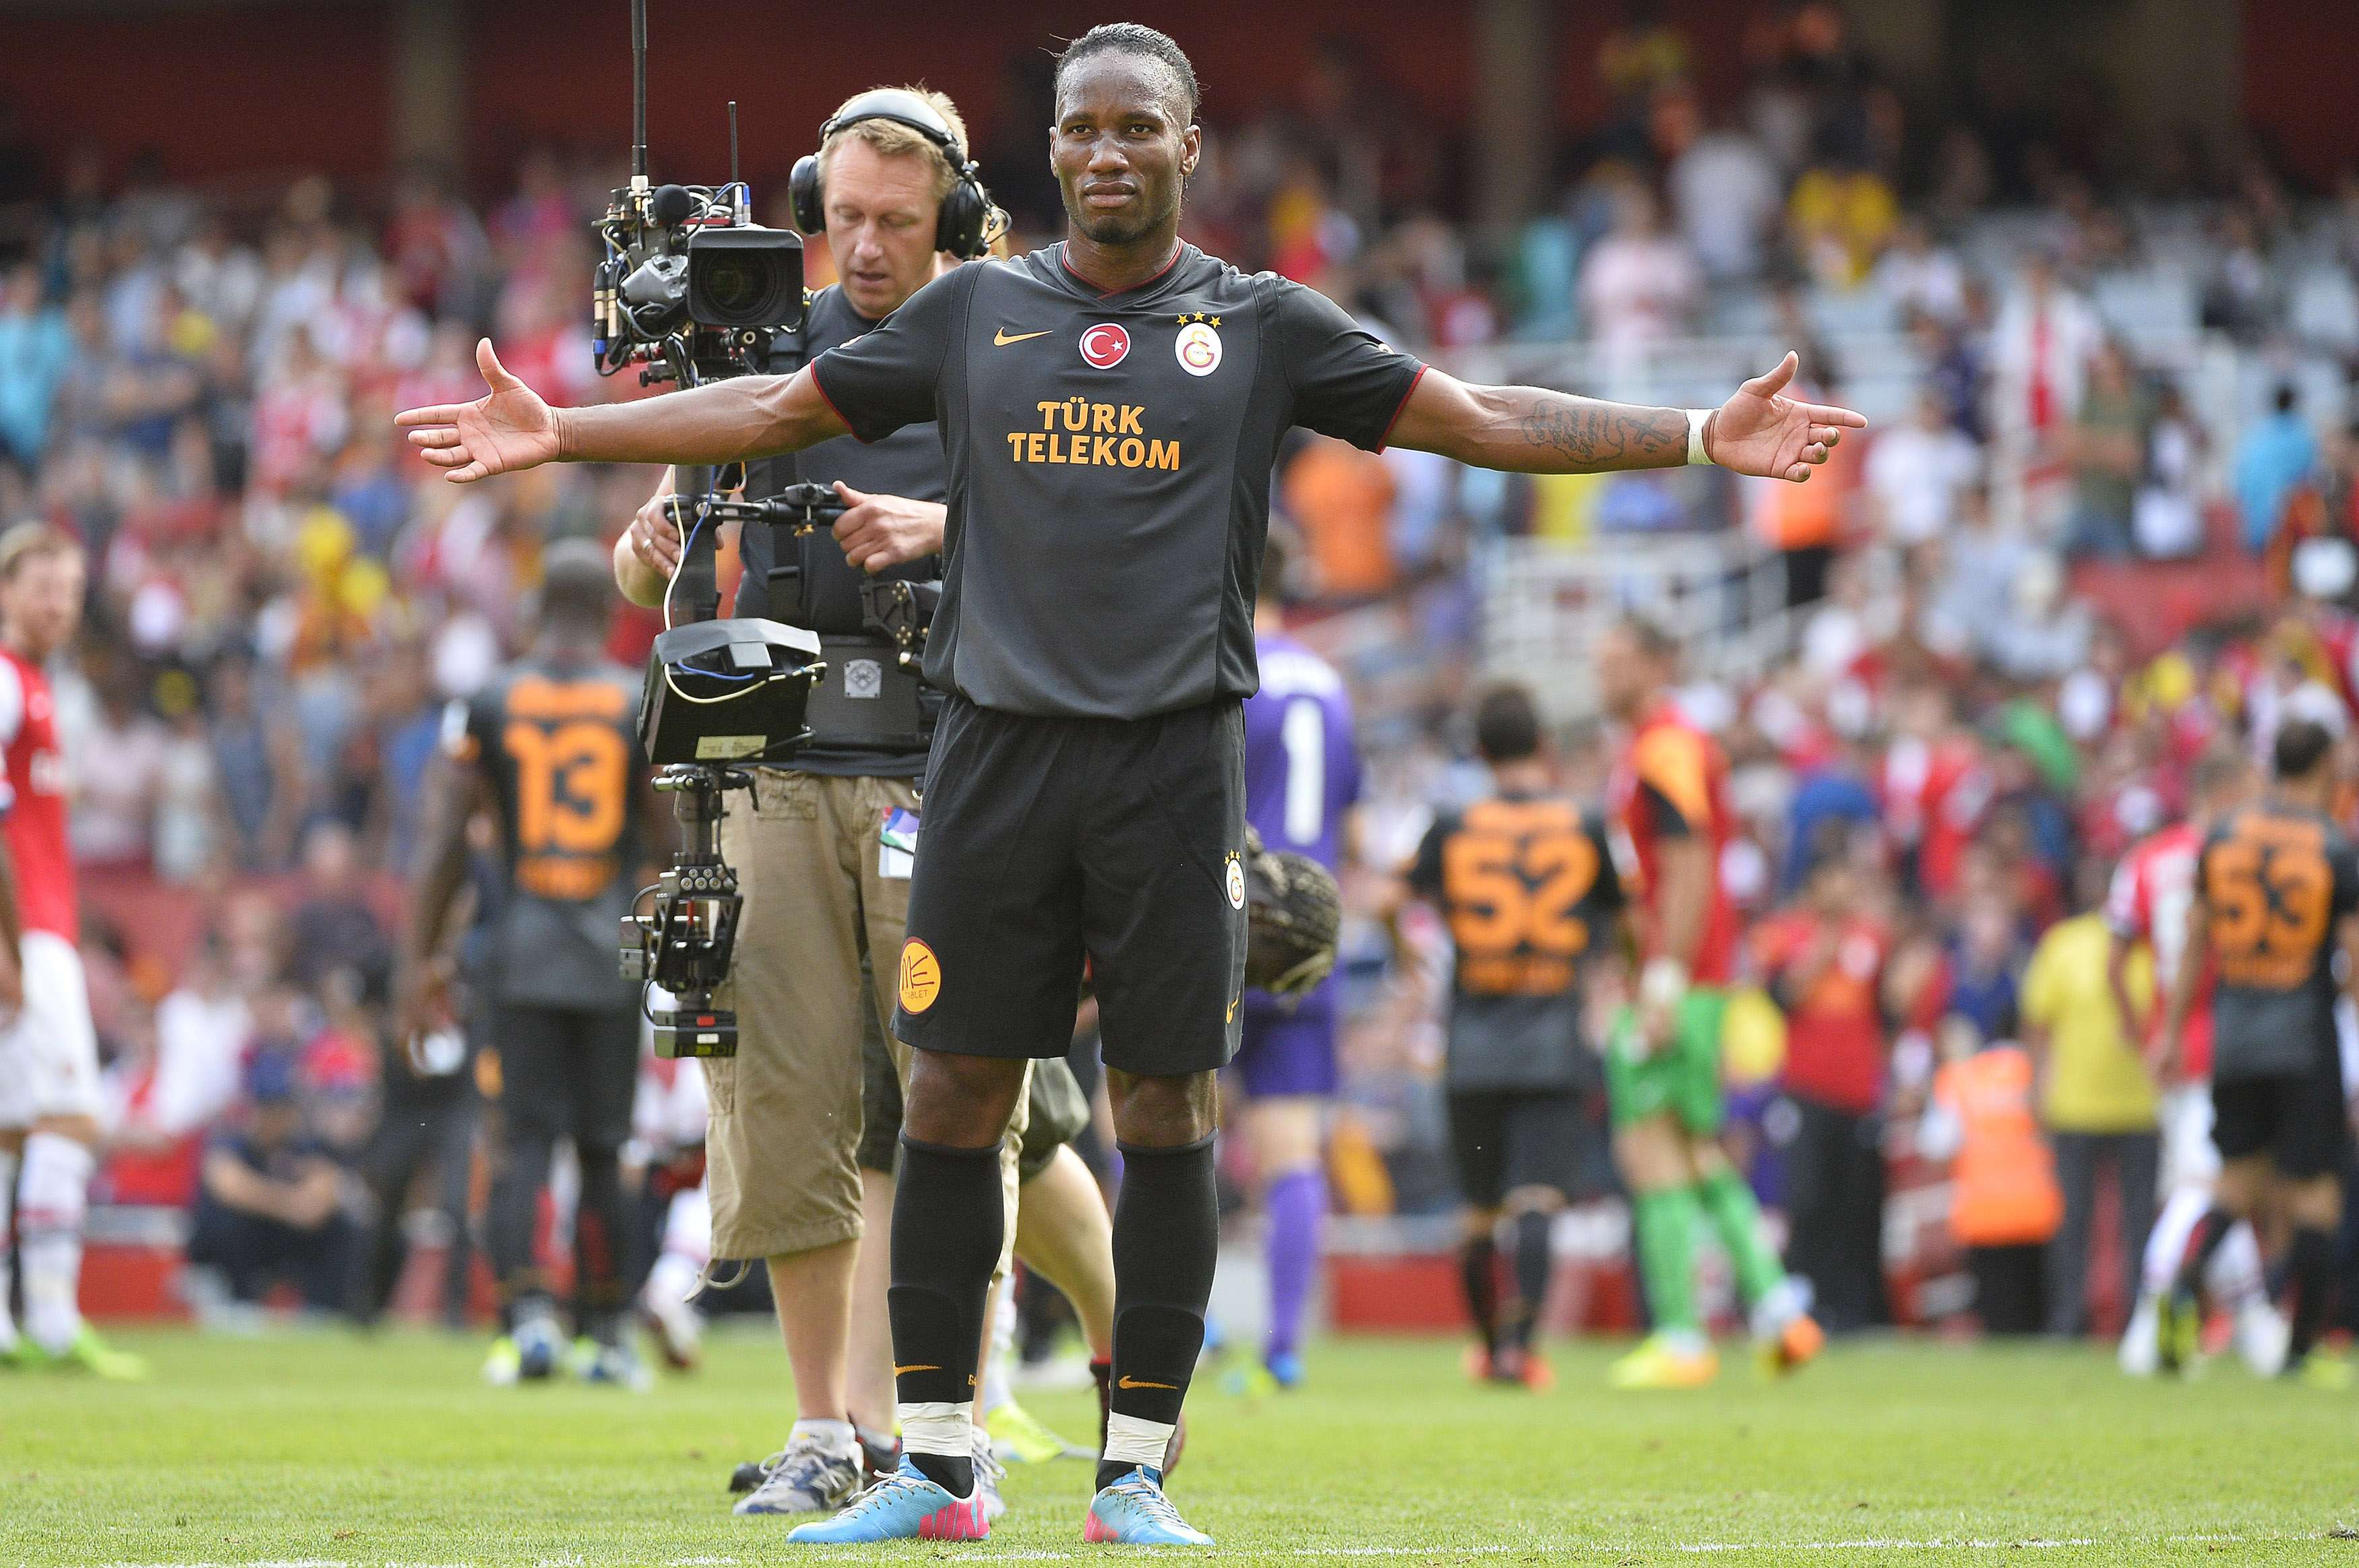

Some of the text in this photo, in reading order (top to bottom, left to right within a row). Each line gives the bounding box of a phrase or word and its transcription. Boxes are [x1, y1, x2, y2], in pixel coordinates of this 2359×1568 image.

[1007, 432, 1180, 470] TELEKOM
[1037, 396, 1145, 435] TÜRK
[503, 720, 627, 852] 13
[1283, 697, 1324, 846] 1
[1443, 833, 1599, 955] 52
[2206, 840, 2333, 957] 53
